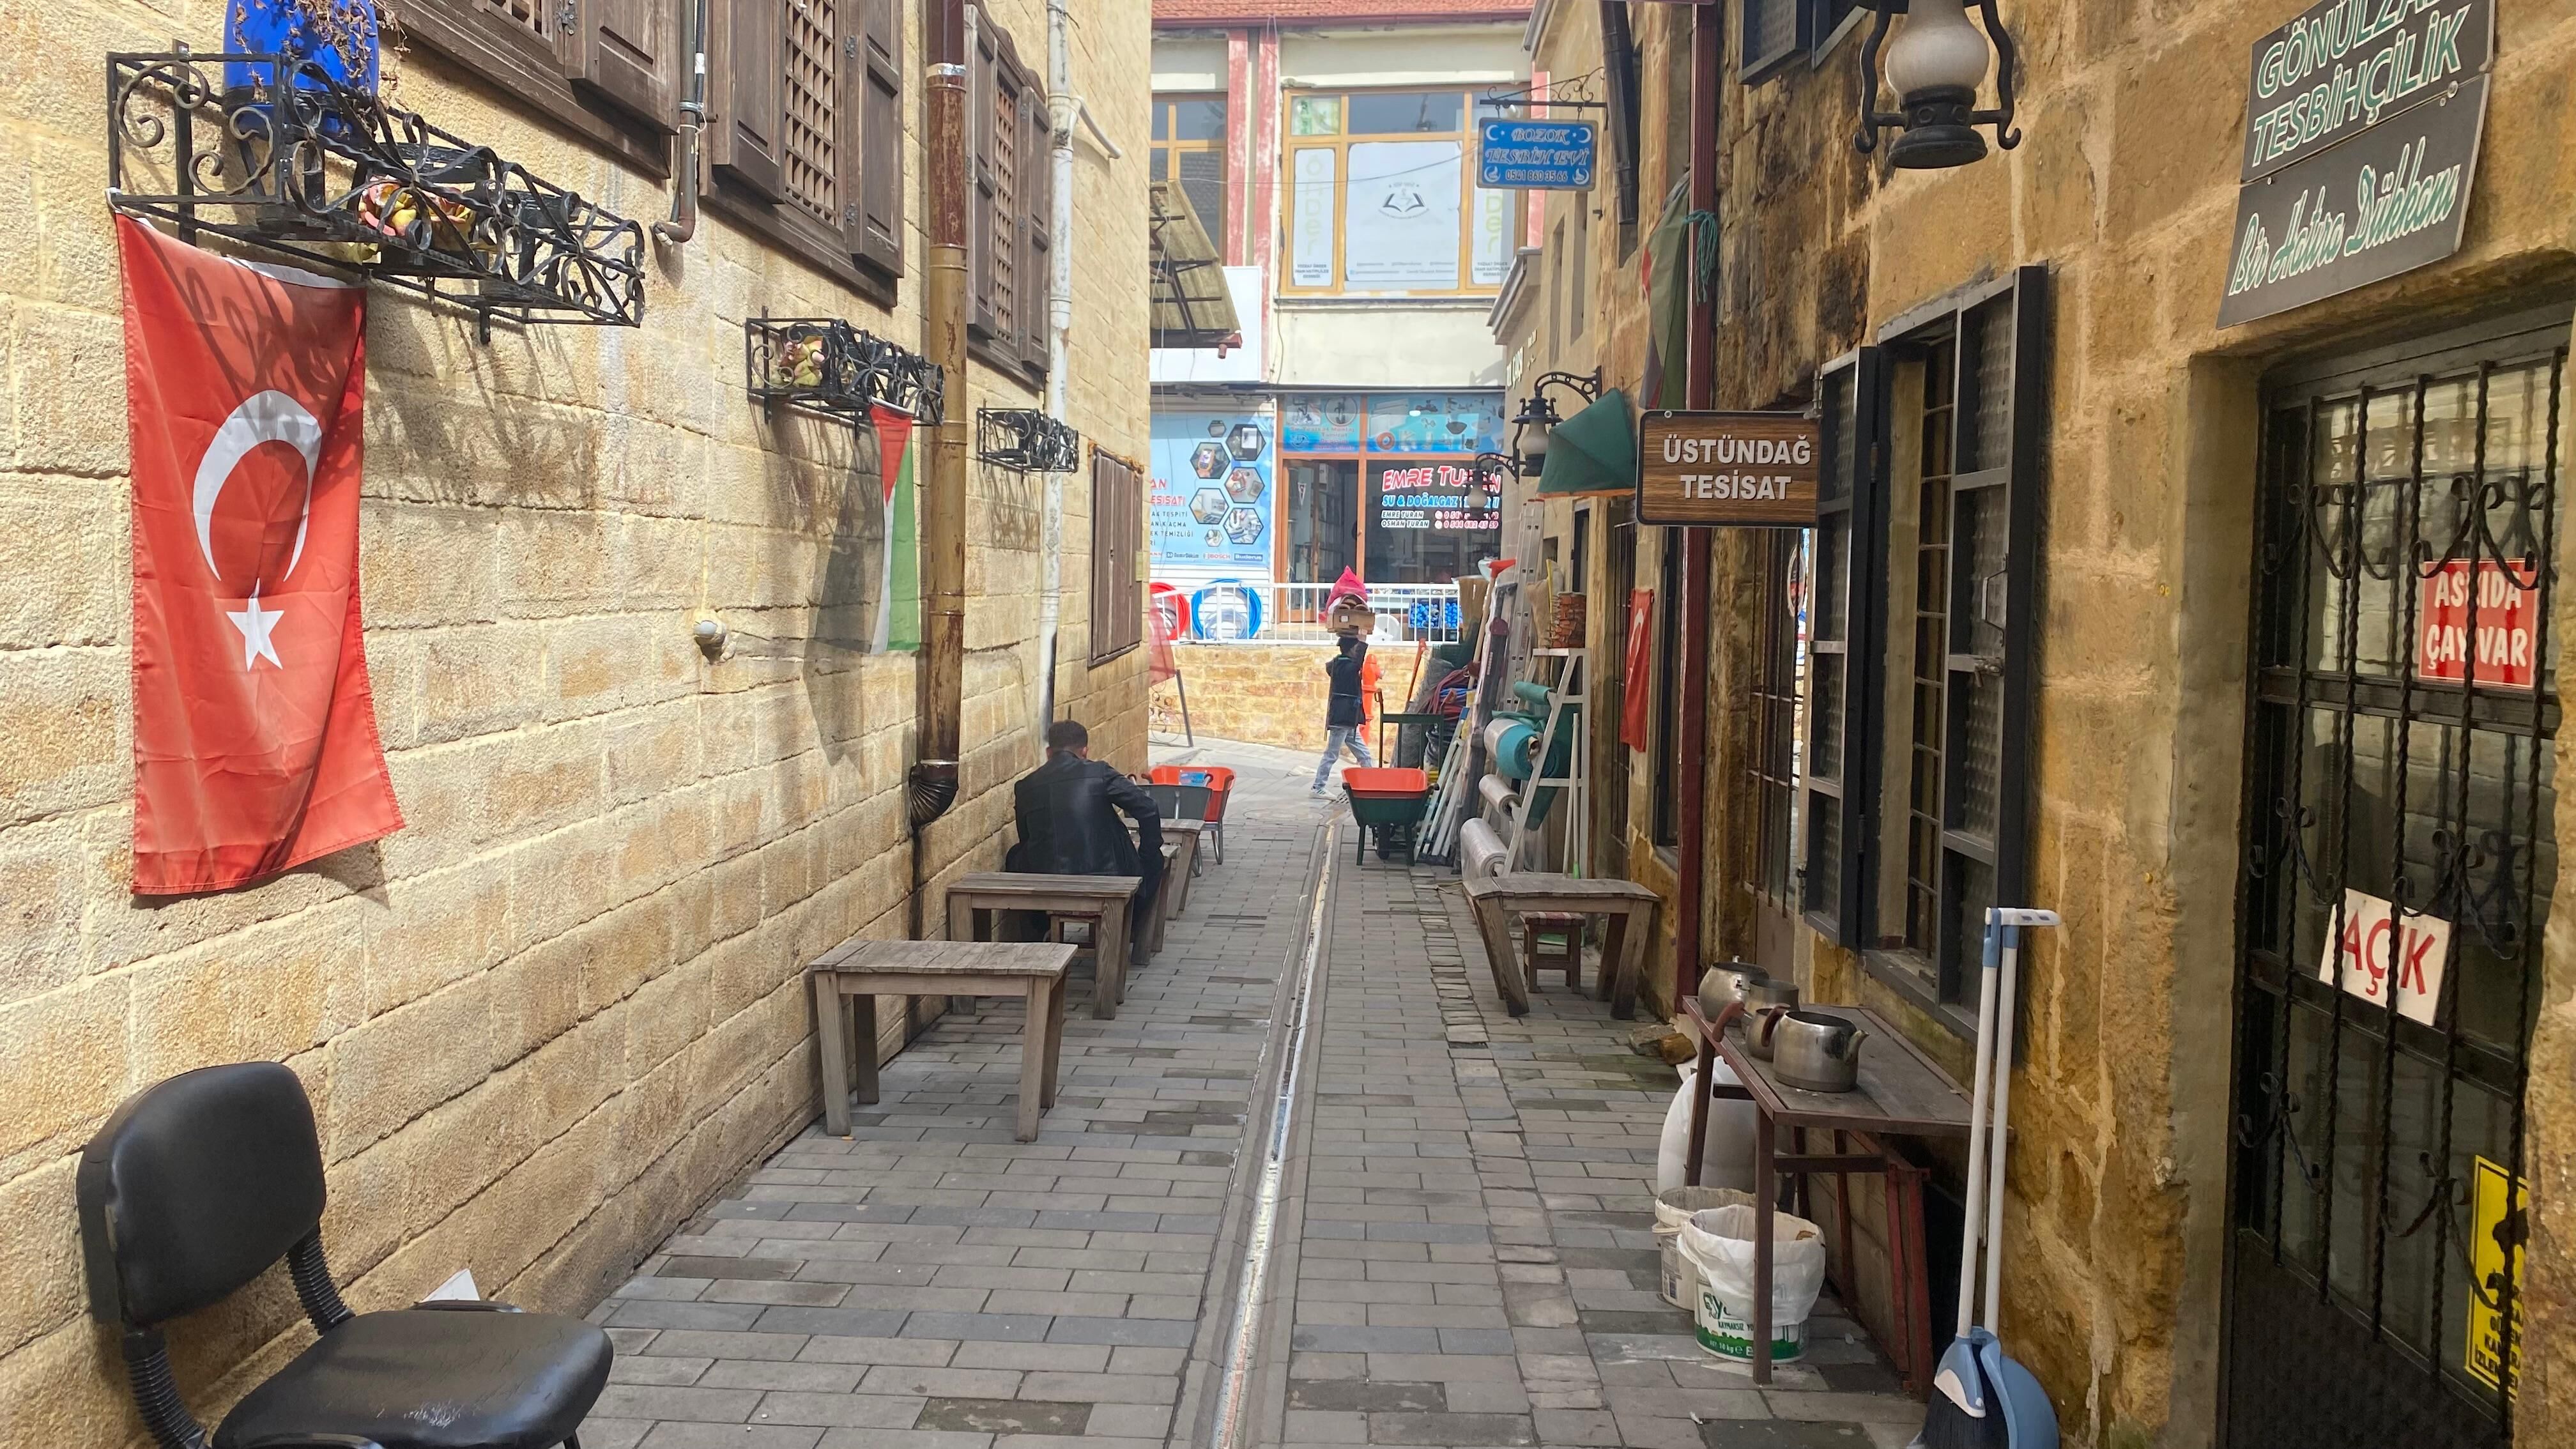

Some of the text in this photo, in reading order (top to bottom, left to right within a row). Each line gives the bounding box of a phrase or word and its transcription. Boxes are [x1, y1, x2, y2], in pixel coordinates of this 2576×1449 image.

[2252, 3, 2472, 168] TESBİHÇİLİK
[1512, 128, 1570, 145] BOZOK
[1485, 146, 1590, 166] TESBİH EVİ
[1506, 169, 1568, 182] 0541 860 35 66
[2228, 213, 2269, 296] Bir
[1664, 434, 1811, 465] ÜSTÜNDAĞ
[1382, 468, 1434, 491] EMRE
[1680, 470, 1792, 500] TESİSAT
[1382, 494, 1396, 507] SU
[1397, 496, 1405, 507] &
[1407, 492, 1459, 507] DOĞALGAZ
[1381, 510, 1400, 519] EMRE
[1400, 510, 1424, 519] TURAN
[1406, 519, 1430, 528] TURAN
[2434, 571, 2522, 610] ASIDA
[2426, 624, 2529, 670] ÇAY VAR
[1717, 1321, 1745, 1331] KAYMAKSIZ
